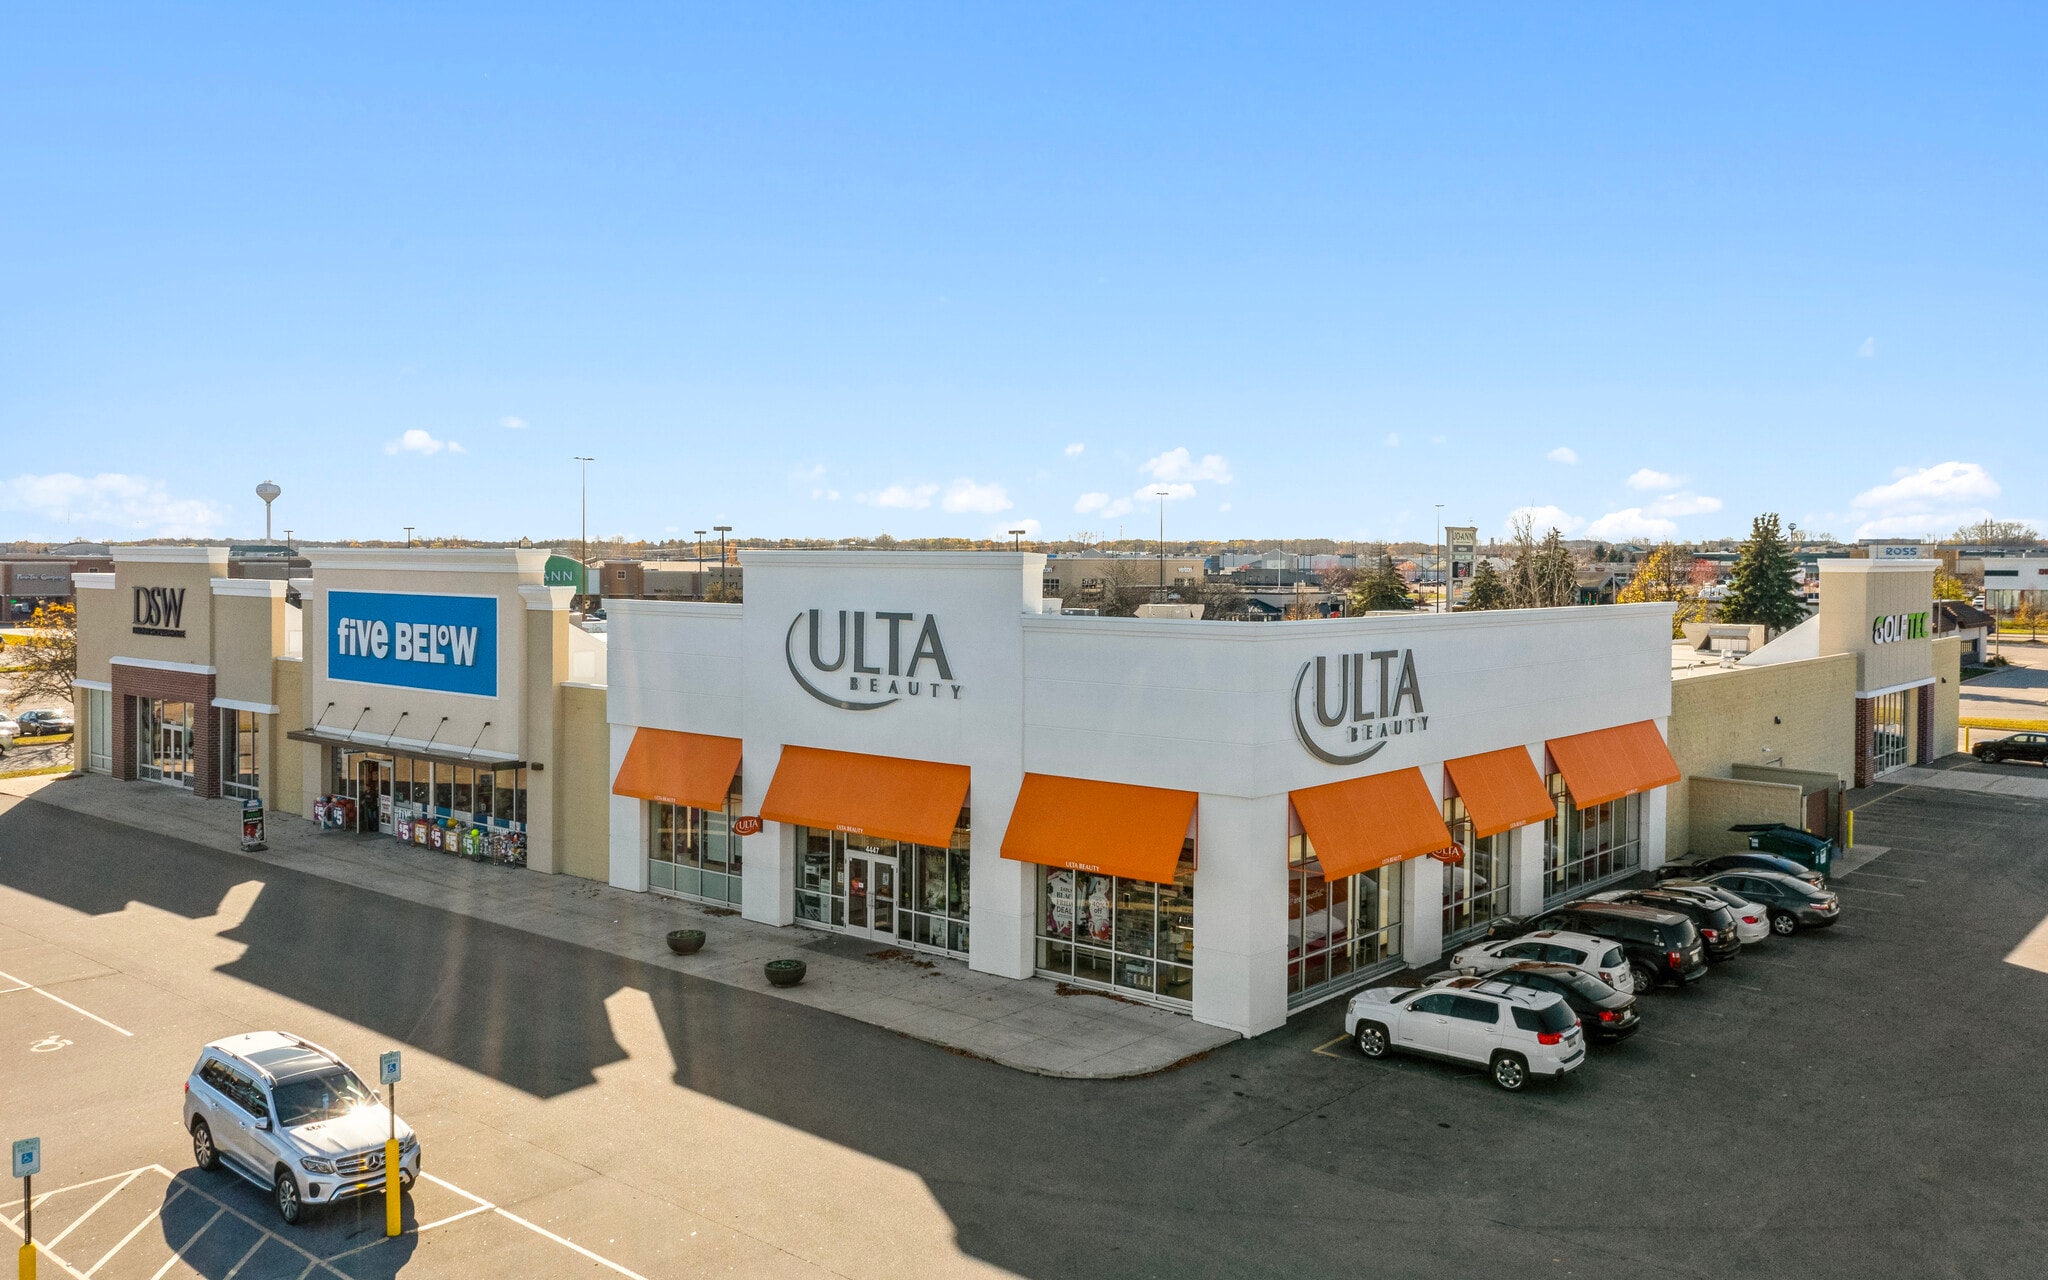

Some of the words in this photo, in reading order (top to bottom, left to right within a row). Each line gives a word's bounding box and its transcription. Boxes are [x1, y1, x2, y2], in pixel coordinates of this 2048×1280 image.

[1886, 547, 1917, 556] ROSS
[132, 586, 186, 628] DSW
[1872, 612, 1929, 645] GOLFTEC
[395, 622, 478, 666] BELOW
[809, 609, 954, 680] ULTA
[850, 676, 962, 700] BEAUTY
[1314, 649, 1424, 727] ULTA
[1348, 716, 1428, 742] BEAUTY
[334, 809, 342, 824] $5
[740, 819, 758, 830] ULTA
[399, 823, 409, 840] $5
[416, 826, 426, 844] $5
[432, 829, 442, 848] $5
[846, 826, 864, 834] BEAUTY
[447, 833, 457, 852] $5
[463, 836, 474, 855] $5
[1078, 864, 1100, 872] BEAUTY
